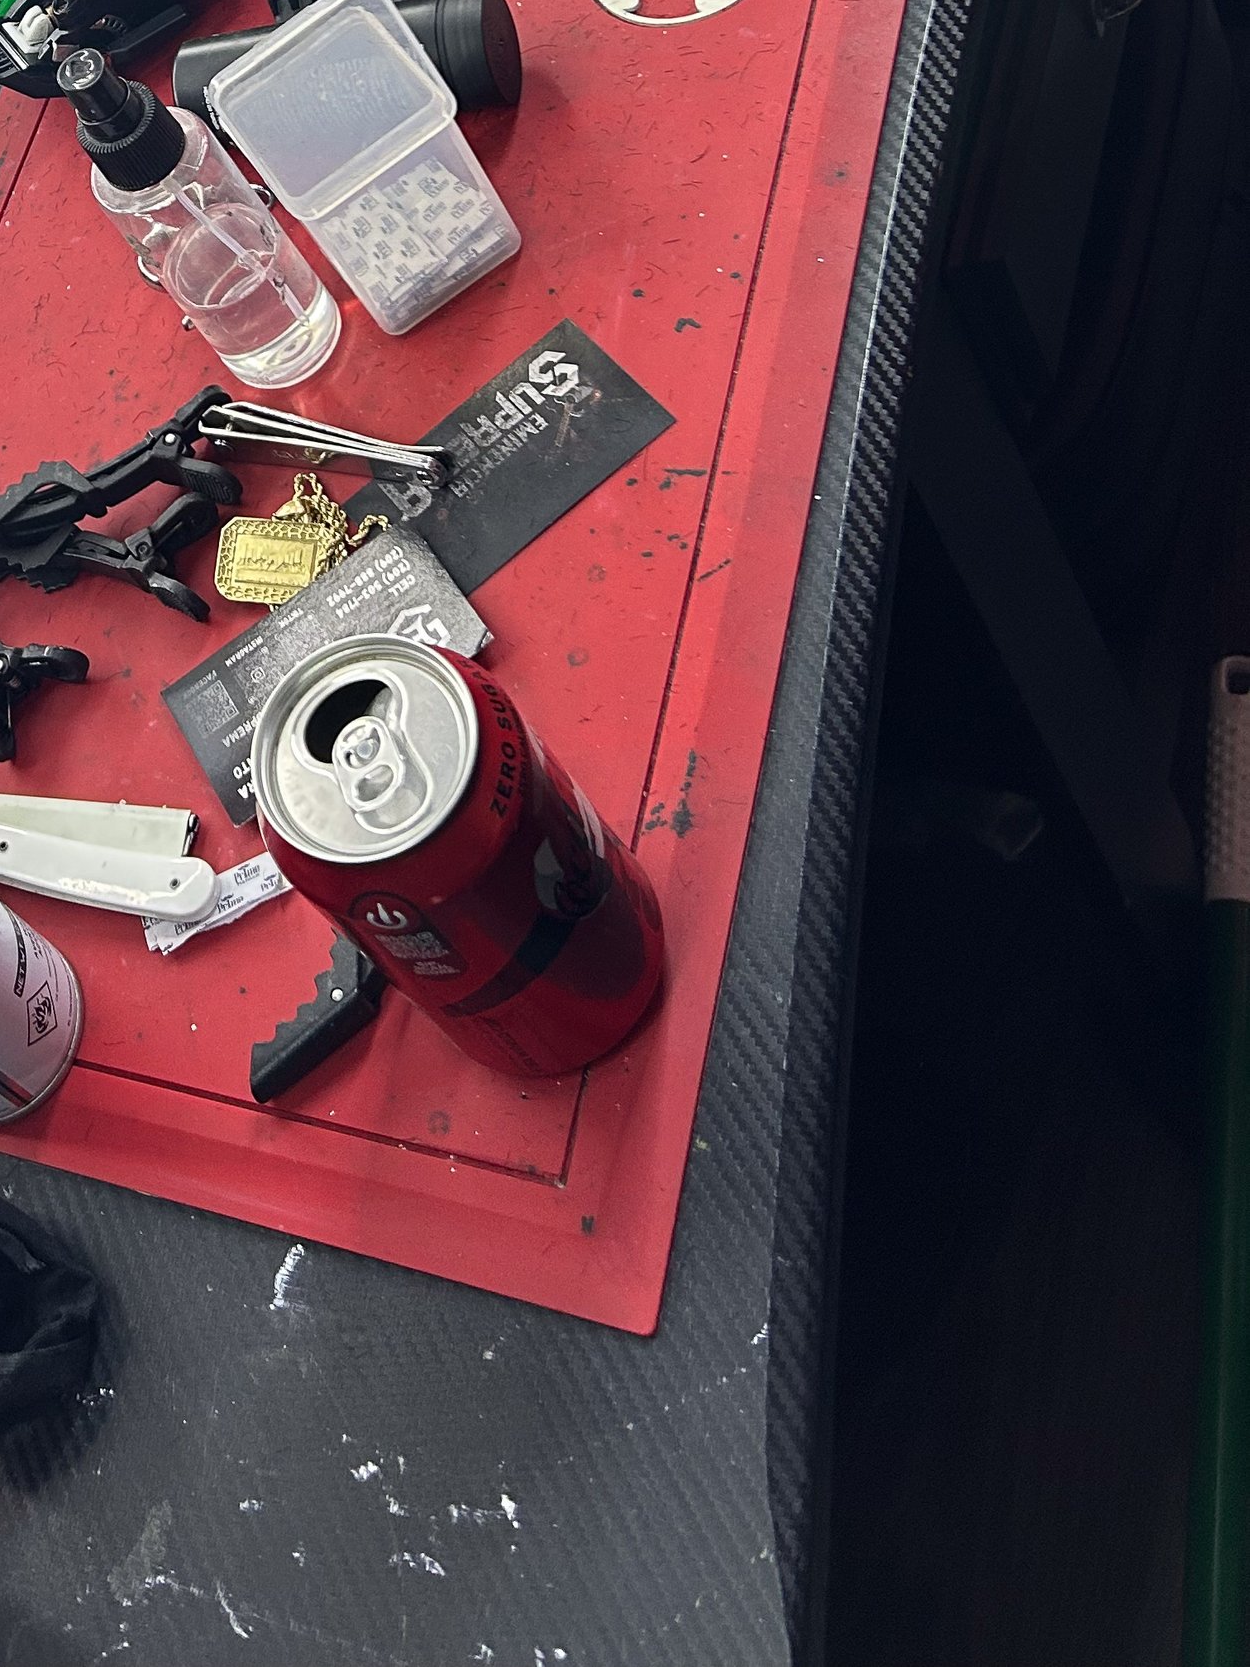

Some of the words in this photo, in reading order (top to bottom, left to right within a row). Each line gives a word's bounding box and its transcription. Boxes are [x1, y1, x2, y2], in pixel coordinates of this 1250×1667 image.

[386, 573, 417, 596] CELL
[223, 634, 264, 668] INSTAGRAM
[489, 741, 517, 818] ZERO
